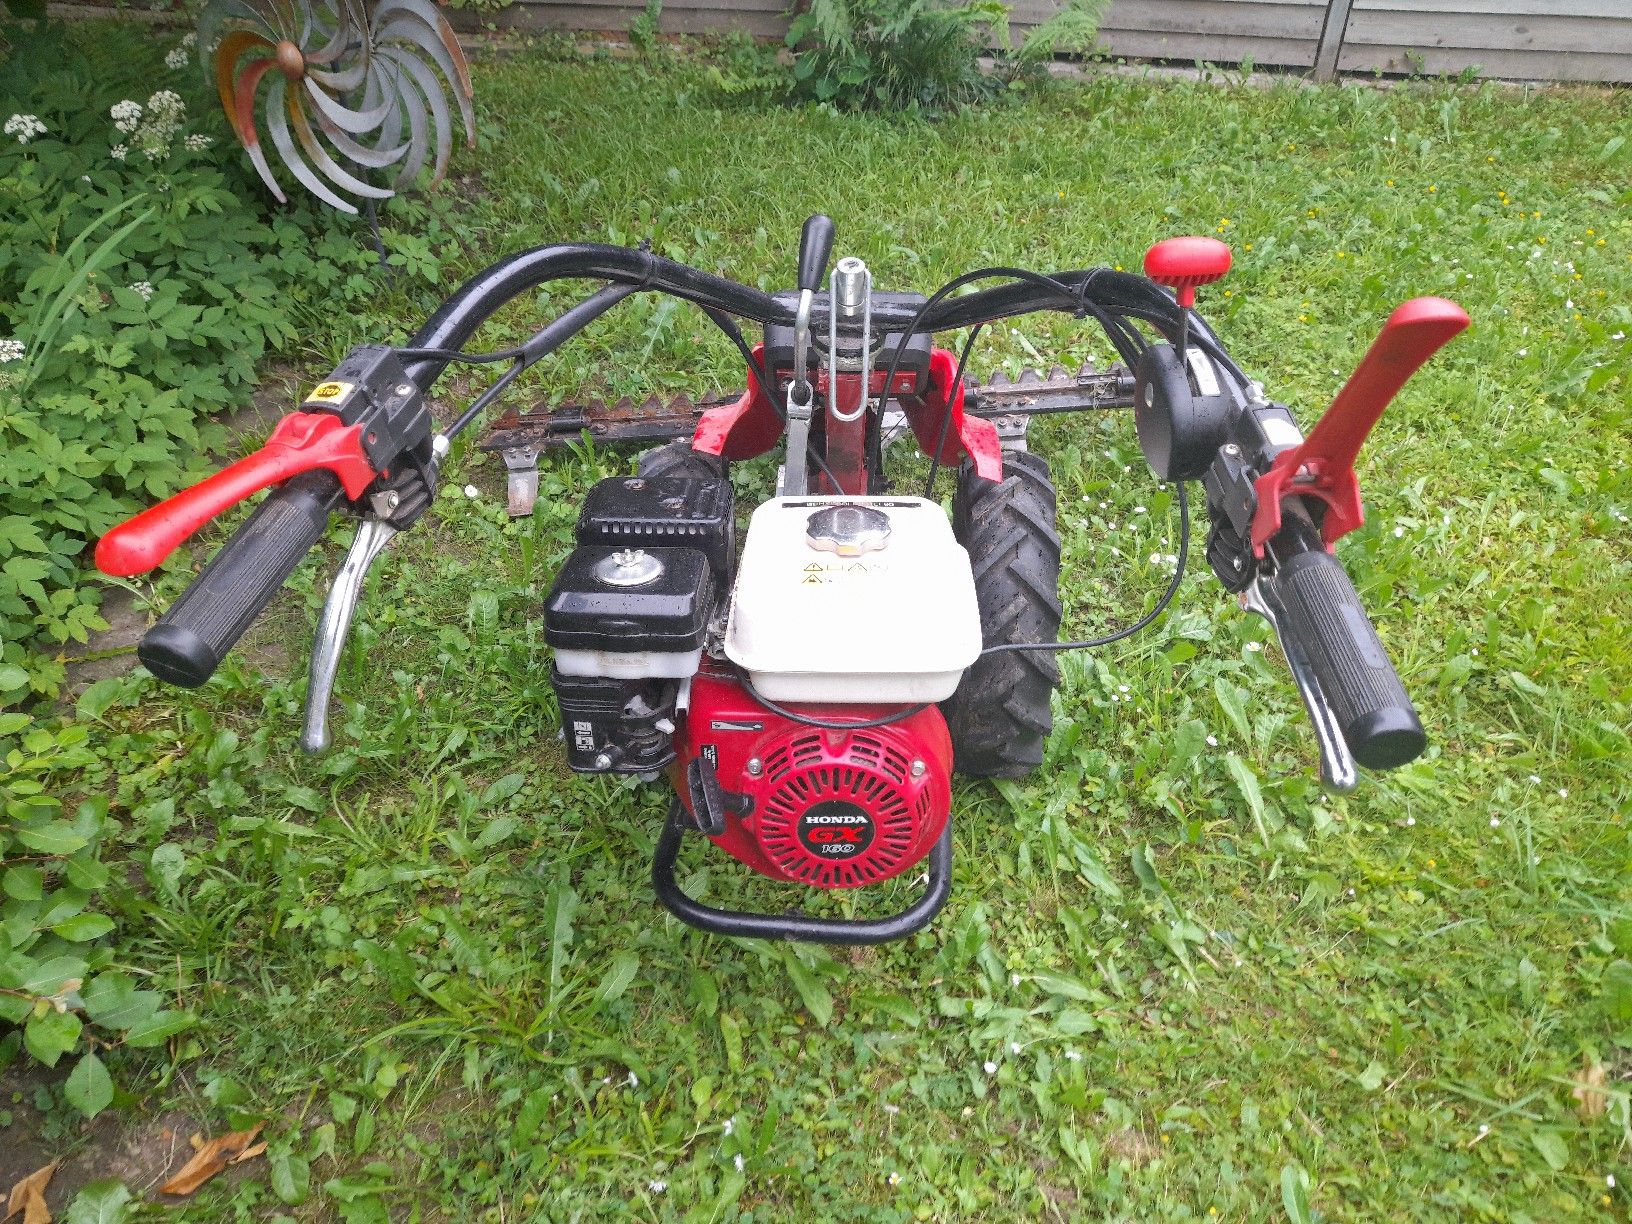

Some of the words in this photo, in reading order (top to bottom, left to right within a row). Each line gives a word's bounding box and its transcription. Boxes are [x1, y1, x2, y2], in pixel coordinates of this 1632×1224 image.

[317, 387, 340, 395] STOP
[808, 826, 864, 843] GX
[822, 844, 855, 853] 160
